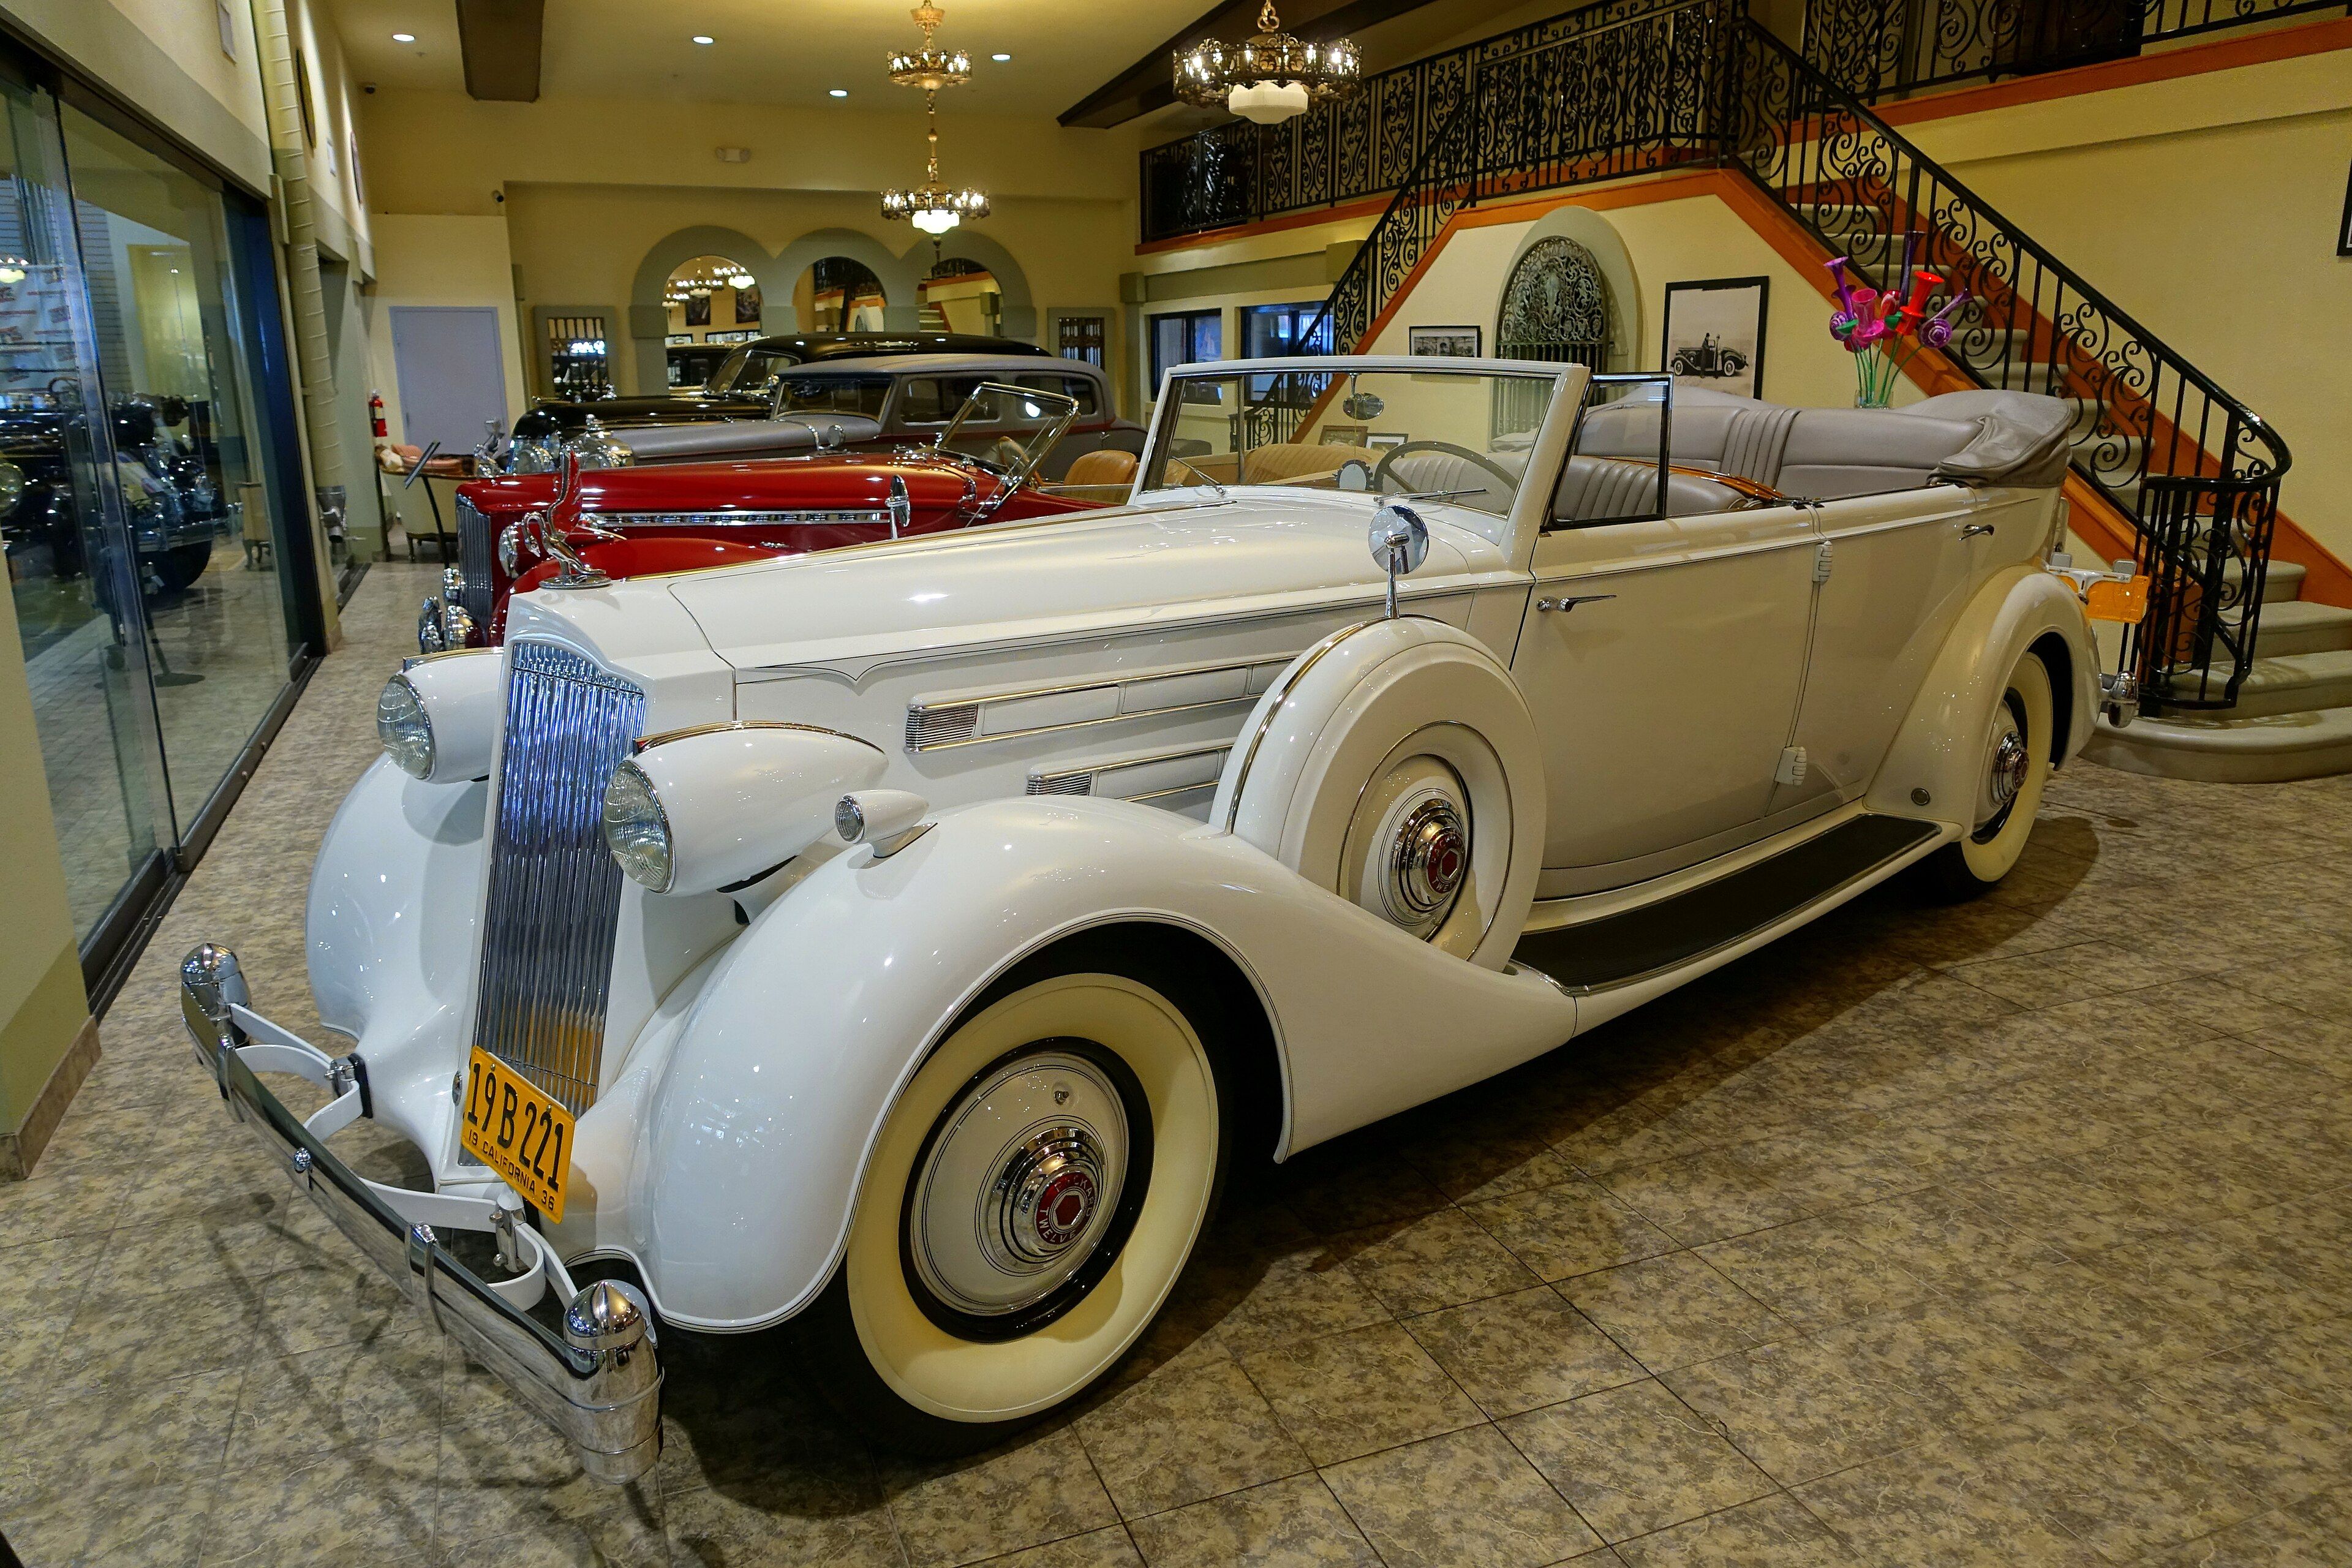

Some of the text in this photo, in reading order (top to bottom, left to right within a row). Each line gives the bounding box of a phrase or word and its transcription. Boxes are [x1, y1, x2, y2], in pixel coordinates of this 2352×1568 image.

[468, 1129, 554, 1211] 19 CALIFORNIA 36
[1055, 1175, 1095, 1217] PCKARD
[1039, 1207, 1076, 1243] TWELVE
